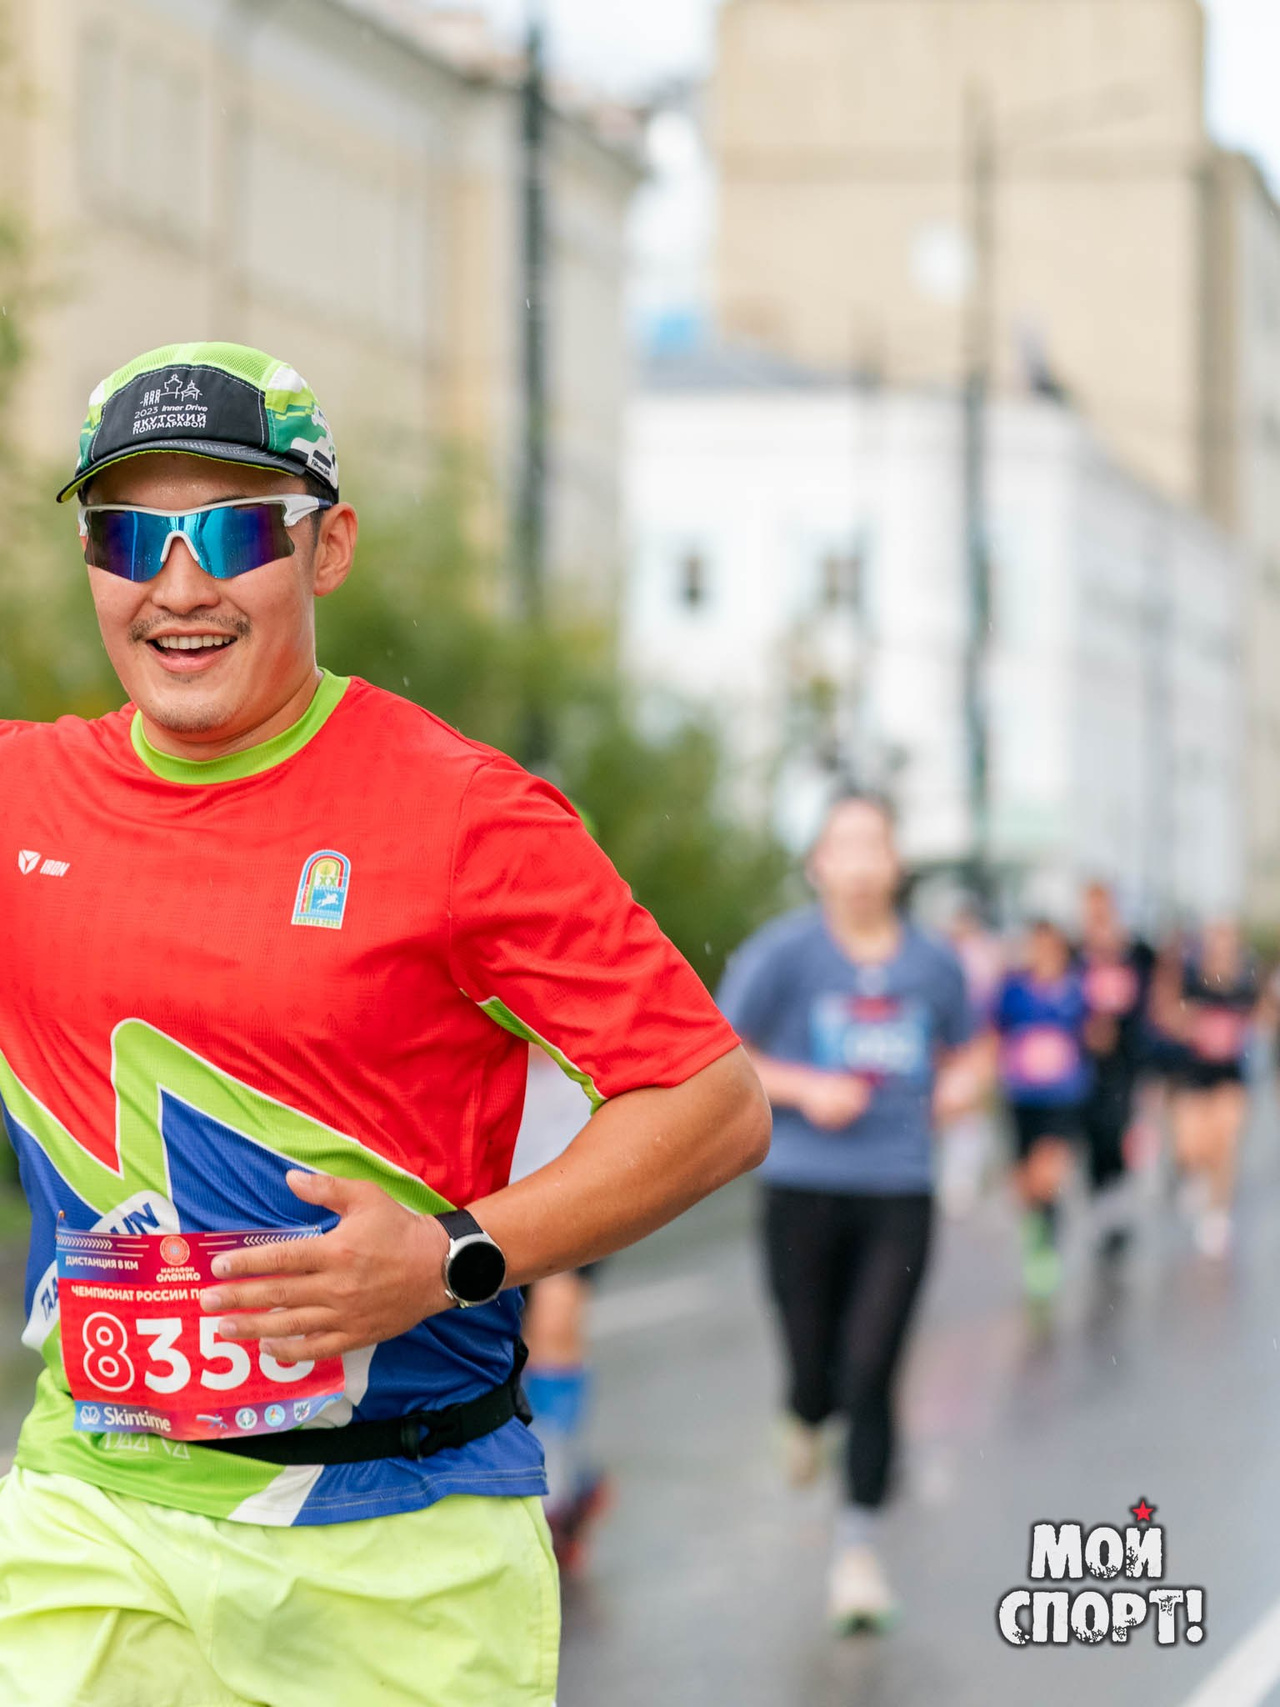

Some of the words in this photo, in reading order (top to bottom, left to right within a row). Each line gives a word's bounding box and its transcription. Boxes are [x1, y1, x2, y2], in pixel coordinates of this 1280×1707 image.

[134, 406, 158, 419] 2023
[185, 404, 208, 412] Drive
[133, 413, 206, 429] ЯКУТСКИЙ
[133, 421, 205, 435] ПОЛУМАРАФОН
[65, 1256, 117, 1270] ДИСТАНЦИЯ
[118, 1260, 123, 1269] 8
[124, 1260, 139, 1270] КМ
[71, 1285, 134, 1301] ЧЕМПИОНАТ
[136, 1290, 188, 1302] РОССИИ
[103, 1406, 171, 1432] Skintime
